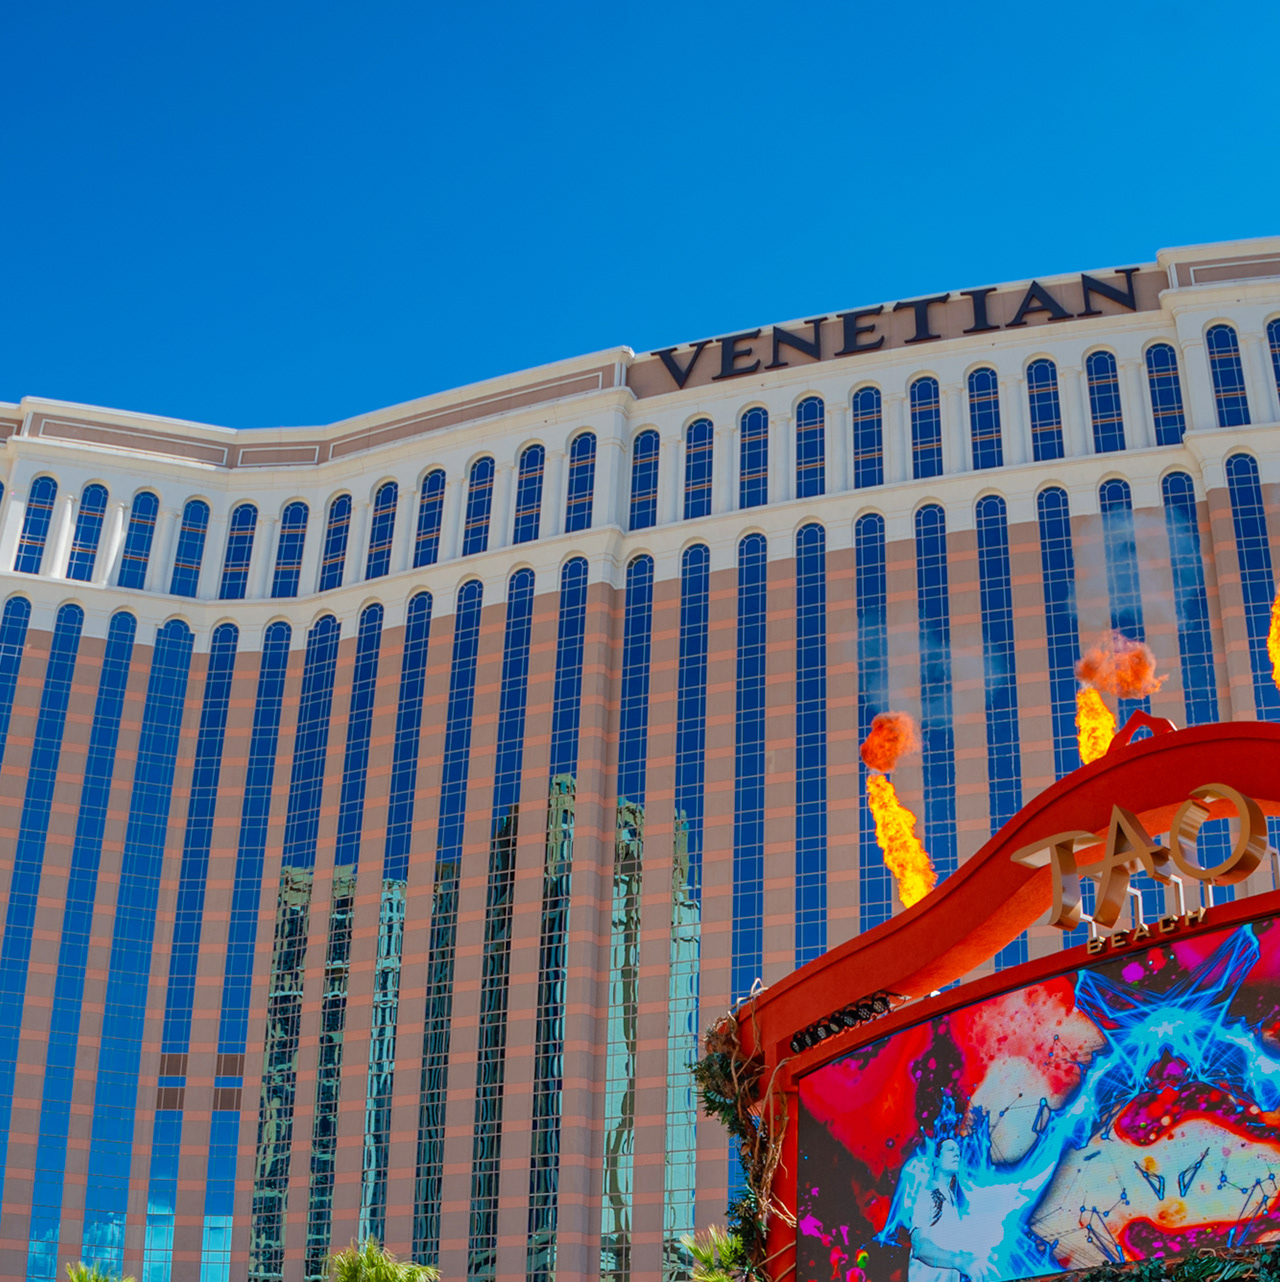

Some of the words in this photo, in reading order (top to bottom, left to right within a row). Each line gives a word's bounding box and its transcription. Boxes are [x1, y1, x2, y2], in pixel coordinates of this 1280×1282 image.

[650, 267, 1141, 389] VENETIAN
[1010, 782, 1267, 931] TAO
[1087, 905, 1208, 954] BEACH
